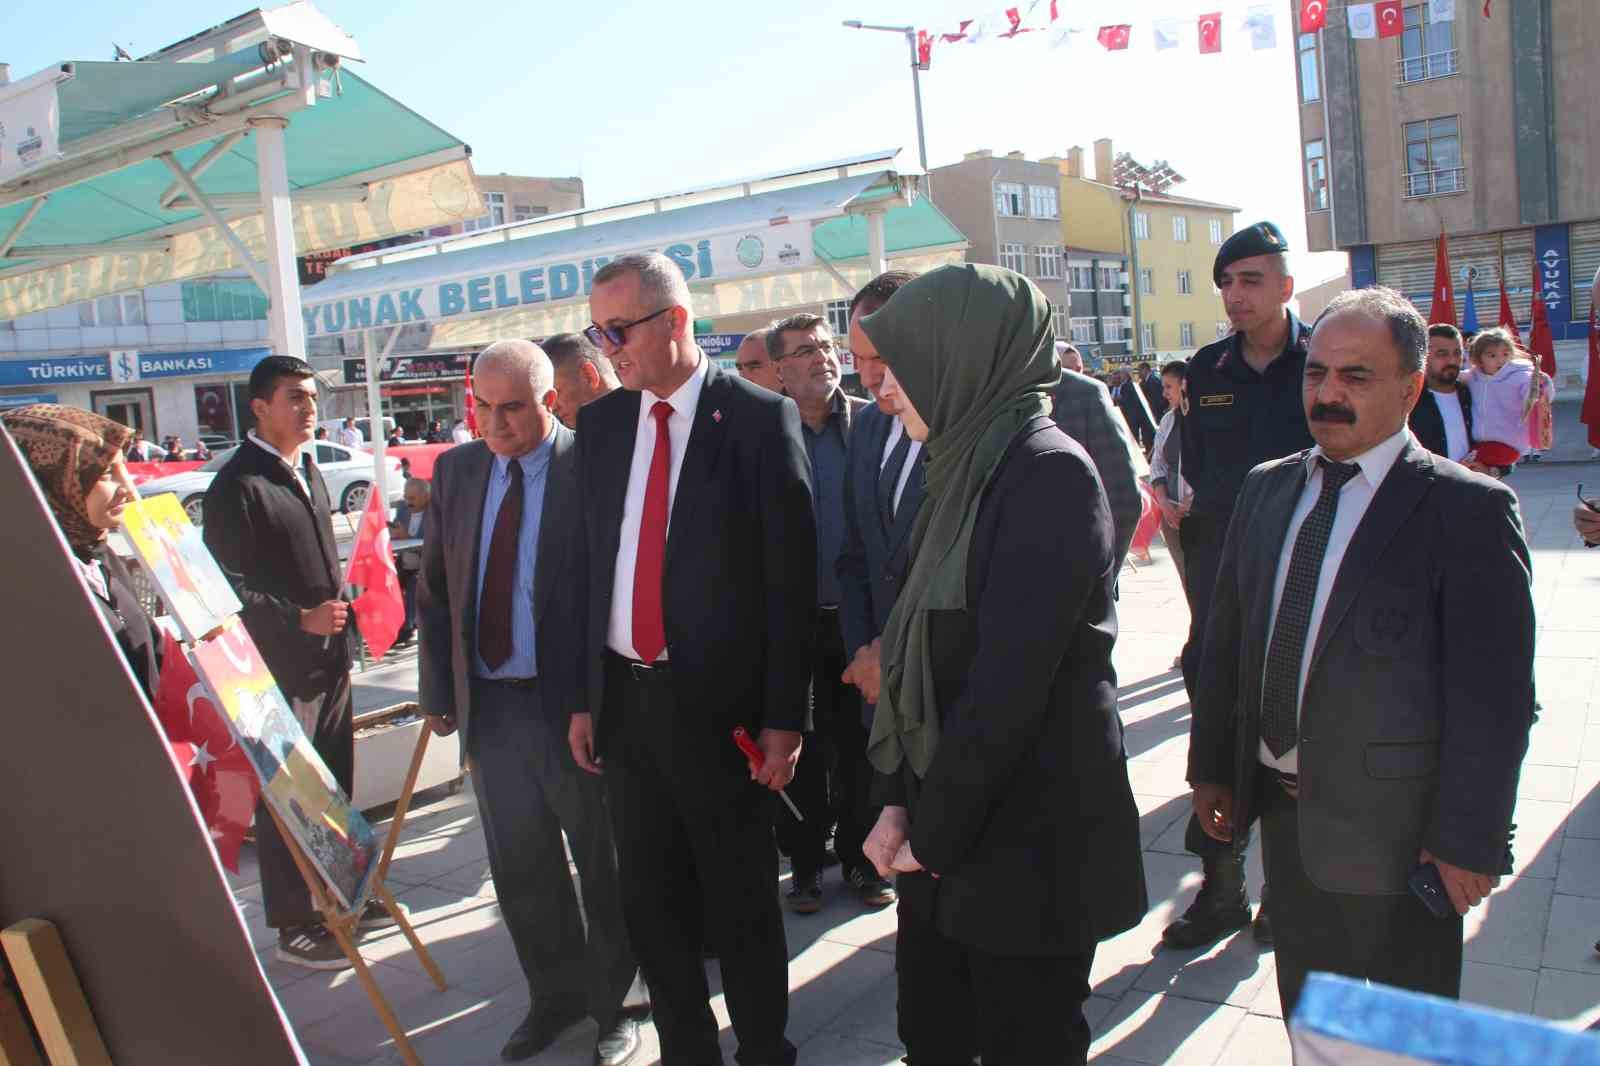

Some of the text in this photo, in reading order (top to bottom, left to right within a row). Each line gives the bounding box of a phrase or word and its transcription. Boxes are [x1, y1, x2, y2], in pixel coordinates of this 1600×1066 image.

[302, 287, 423, 335] YUNAK
[439, 240, 712, 316] BELEDİSİ
[1543, 249, 1561, 309] AVUKAT
[27, 358, 212, 378] TÜRKİYE BANKASI
